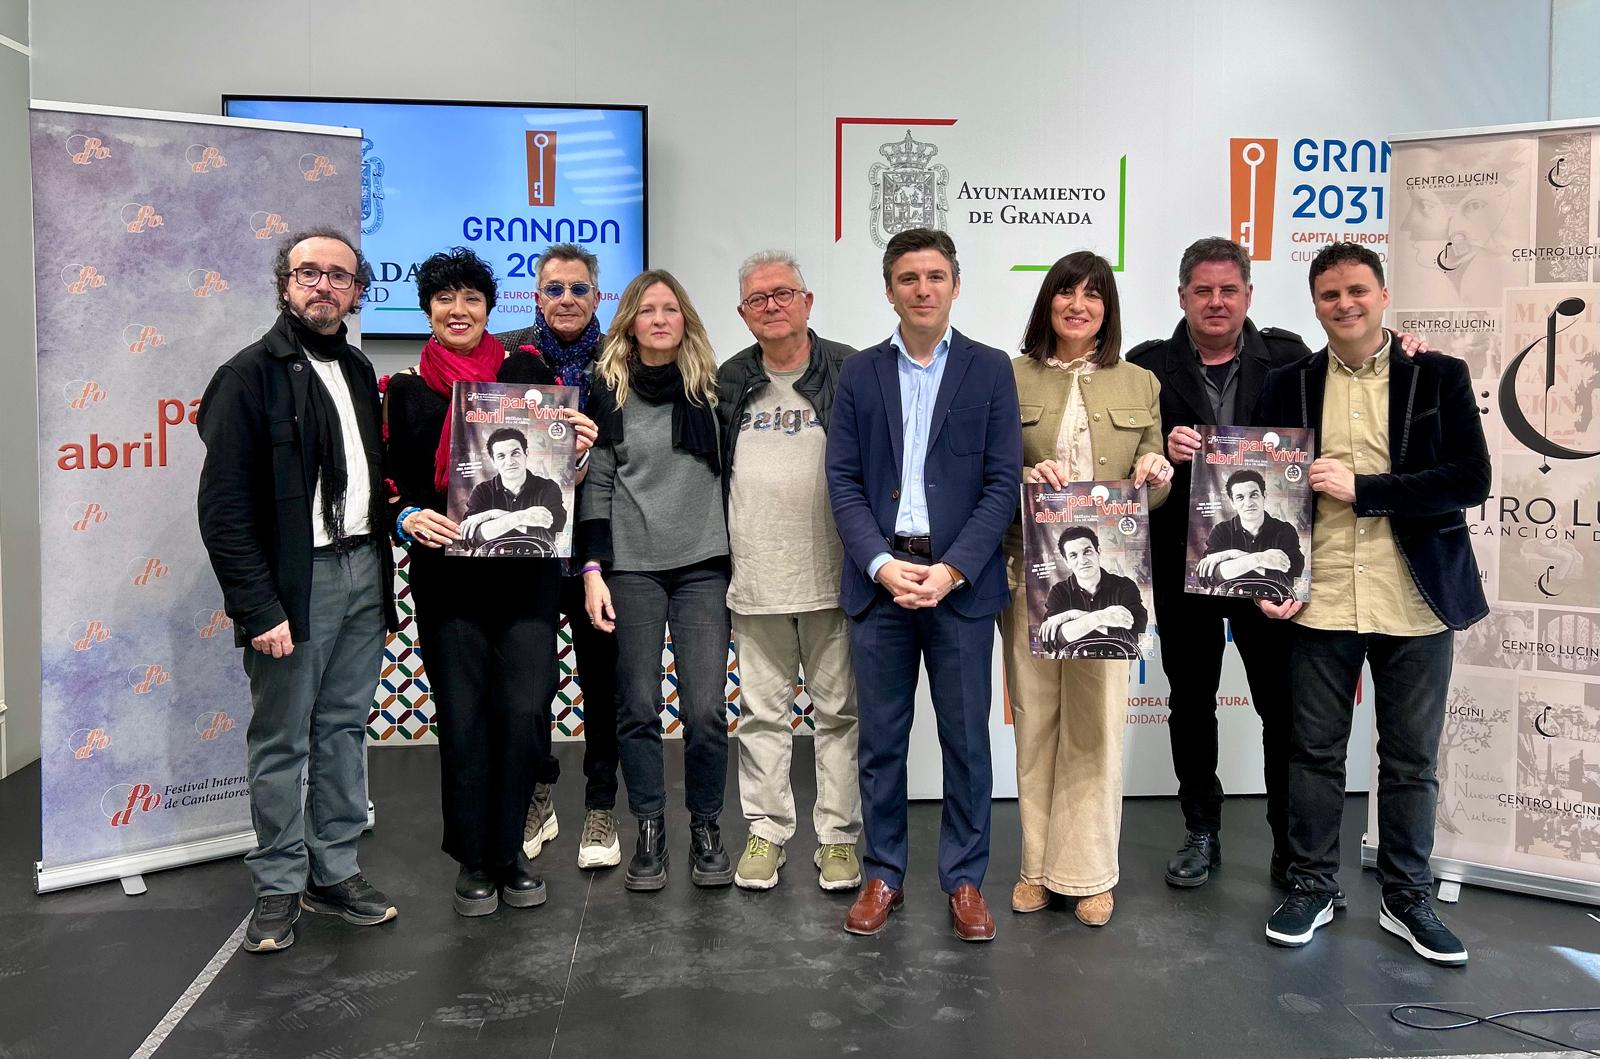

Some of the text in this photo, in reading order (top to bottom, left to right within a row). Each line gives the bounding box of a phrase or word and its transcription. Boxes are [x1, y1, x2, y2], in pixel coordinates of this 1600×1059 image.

[1406, 172, 1498, 186] CENTRO LUCINI
[1292, 184, 1384, 224] 2031
[463, 216, 620, 244] GRANADA
[1292, 232, 1339, 243] CAPITAL
[1512, 246, 1600, 258] CENTRO LUCI
[497, 305, 532, 313] CIUDAD
[1403, 319, 1495, 328] CENTRO LUCINI
[500, 396, 537, 409] para
[466, 408, 504, 424] abril
[534, 405, 568, 420] vivi
[57, 432, 167, 470] abril
[1238, 440, 1275, 452] para
[1206, 450, 1244, 465] abril
[1272, 448, 1308, 462] vivir
[1067, 495, 1104, 507] para
[1102, 499, 1140, 515] vivir
[1036, 508, 1072, 523] abril
[1469, 524, 1575, 540] CANCIÓN
[1502, 640, 1555, 653] CENTRO
[1445, 706, 1484, 717] UCINI
[164, 778, 208, 796] Festival
[164, 788, 250, 810] de Cantautores
[1499, 793, 1552, 809] CENTRO
